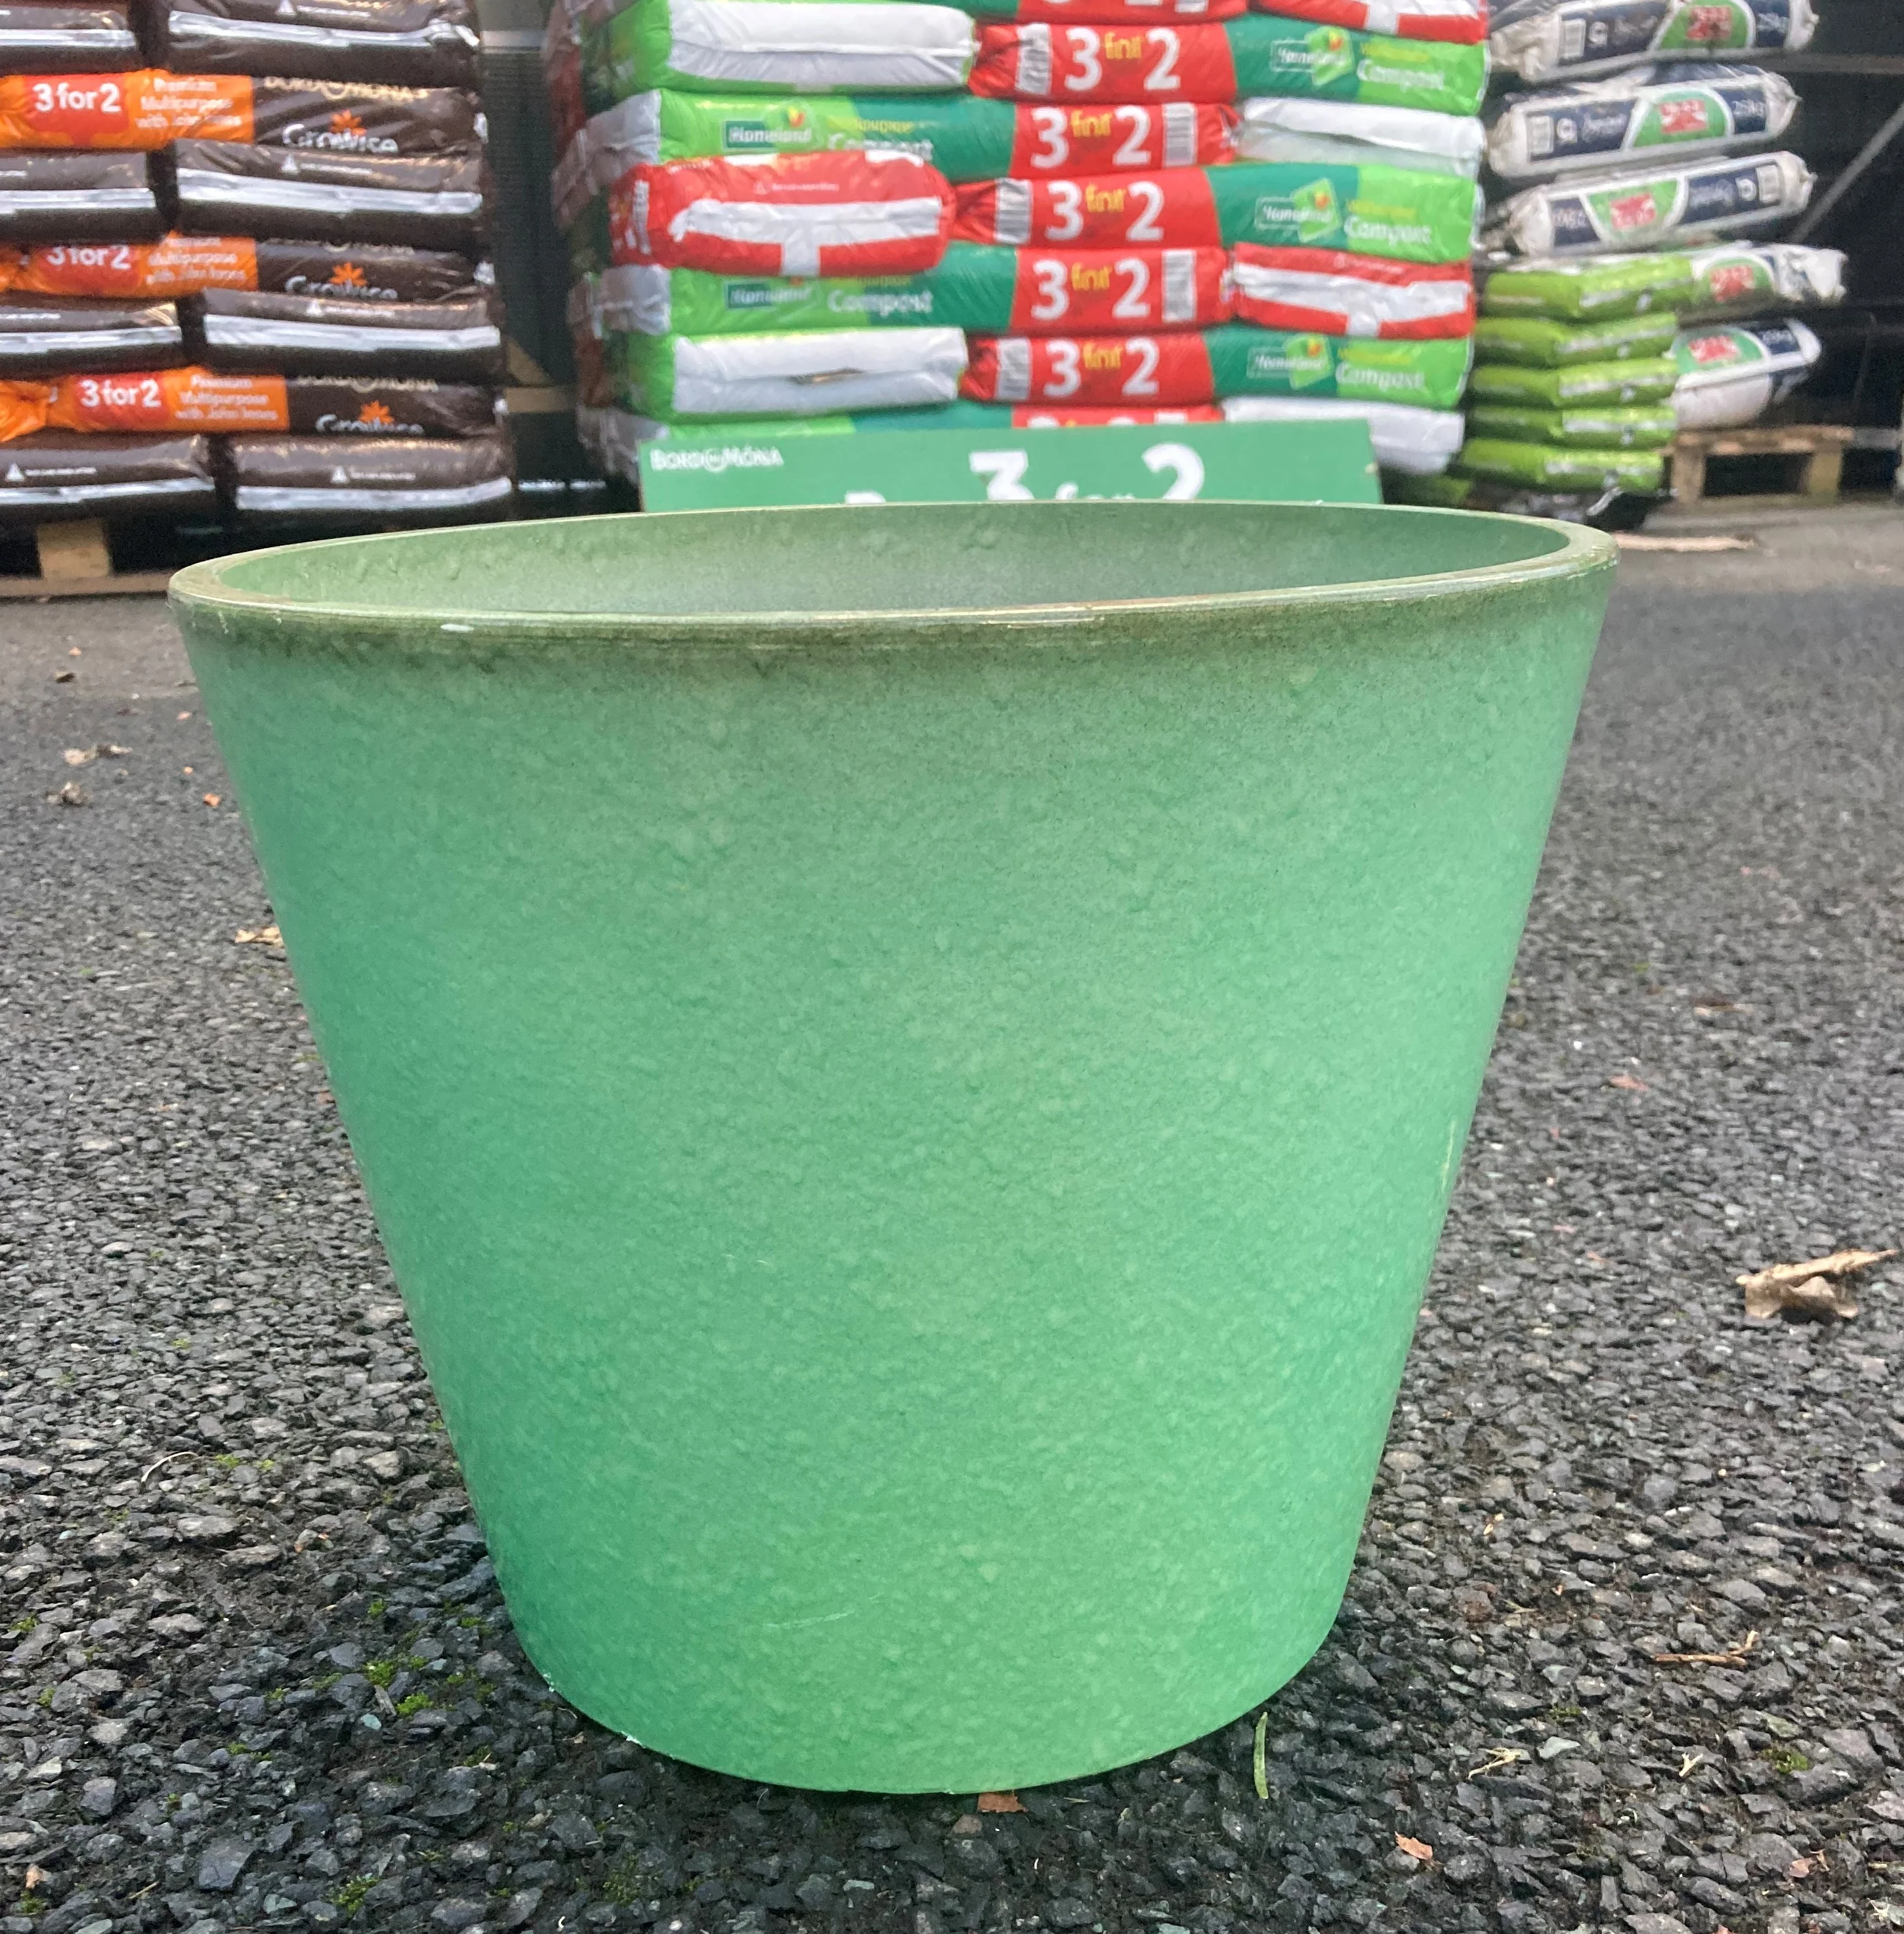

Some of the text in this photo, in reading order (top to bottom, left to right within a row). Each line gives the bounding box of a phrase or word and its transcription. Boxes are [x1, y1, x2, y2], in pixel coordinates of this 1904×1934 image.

[1065, 26, 1102, 91] 3
[1143, 27, 1181, 91] 2
[33, 82, 121, 113] 3 for 2
[1030, 106, 1069, 169] 3
[1112, 105, 1152, 166] 2
[1045, 180, 1083, 241] 3
[1126, 181, 1164, 242] 2
[47, 247, 64, 266] 3
[110, 245, 131, 270] 2
[1030, 259, 1069, 320] 3
[1112, 257, 1151, 318] 2
[80, 379, 162, 408] 3 for 2
[1043, 339, 1081, 398] 3
[1121, 337, 1160, 396] 2
[1141, 442, 1204, 499] 2
